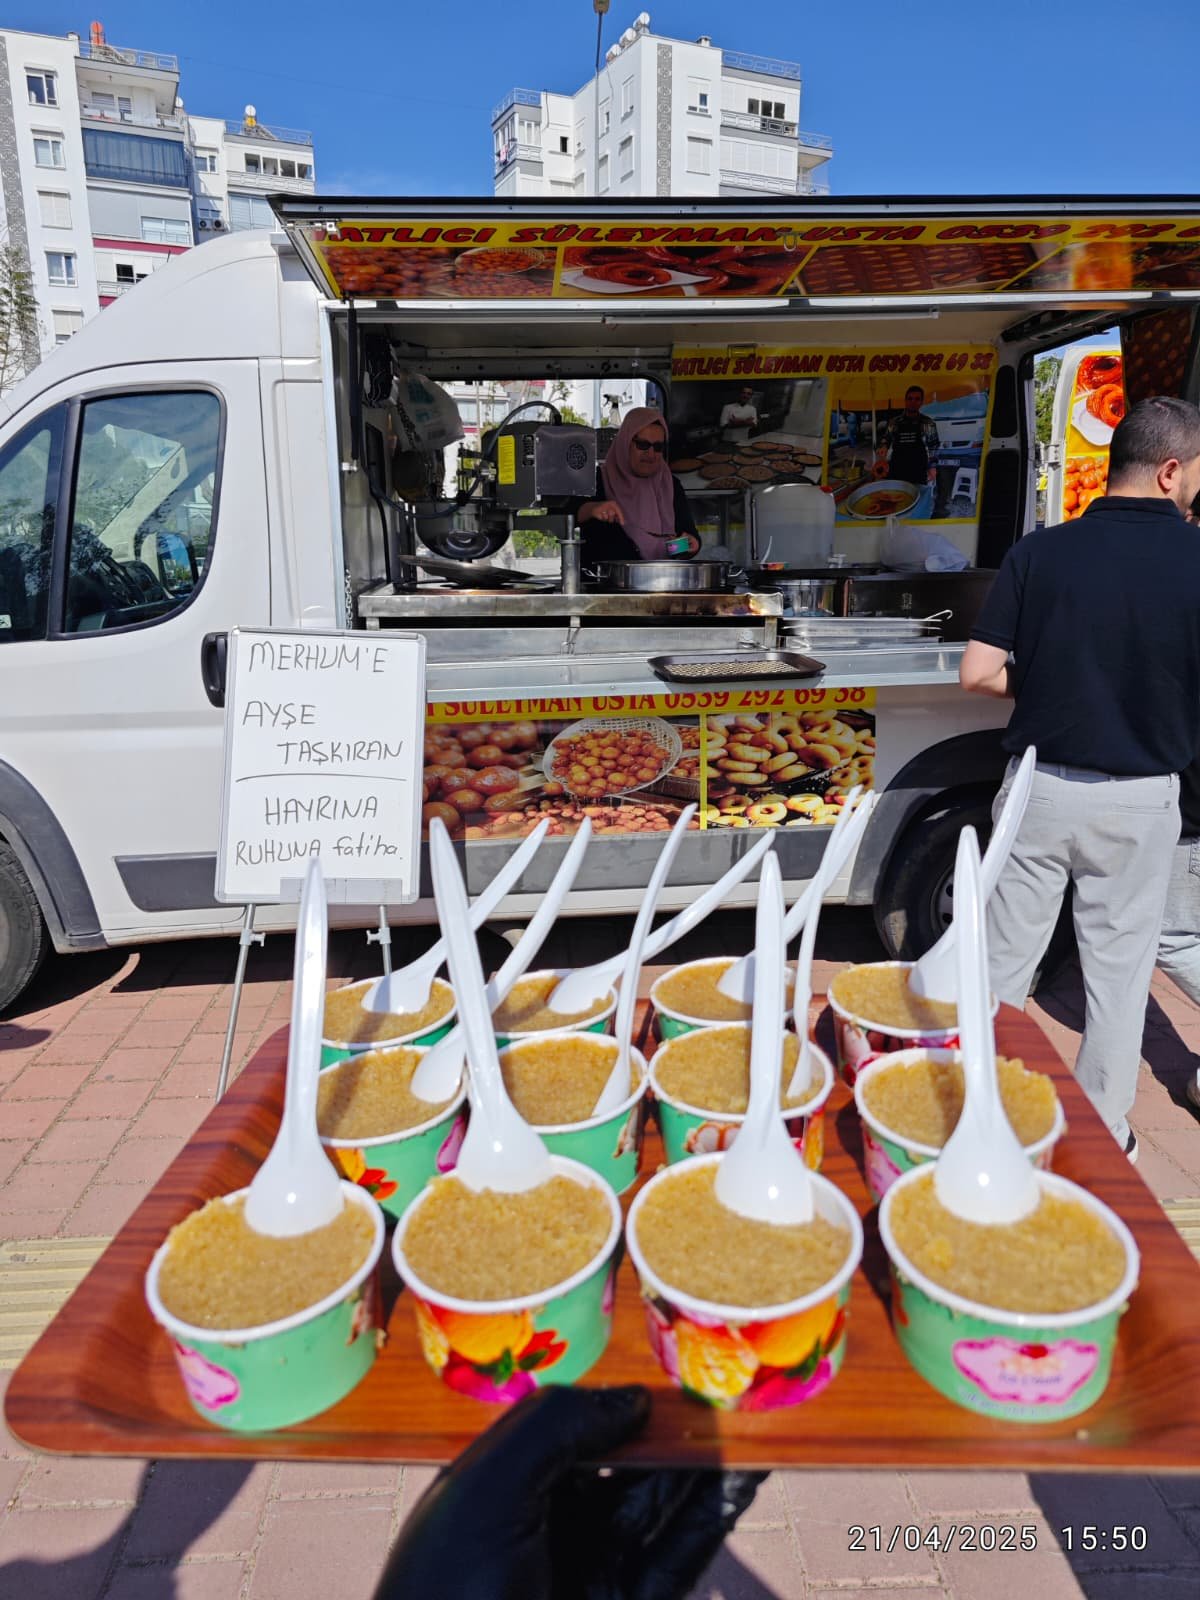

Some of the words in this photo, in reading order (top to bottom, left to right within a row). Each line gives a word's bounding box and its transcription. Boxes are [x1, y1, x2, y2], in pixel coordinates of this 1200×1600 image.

[508, 224, 792, 242] SÜLEYMAN
[800, 225, 927, 241] USTA
[936, 224, 1071, 240] 0539
[825, 354, 865, 373] USTA
[868, 354, 910, 373] 0539
[912, 353, 944, 372] 292
[946, 353, 969, 371] 69
[248, 640, 389, 673] MERHUM'E
[664, 691, 730, 709] 0539
[738, 690, 785, 706] 292
[794, 688, 826, 705] 69
[834, 687, 866, 703] 38
[242, 700, 317, 730] AYŞE
[277, 740, 404, 766] TAŞKIRAN
[265, 795, 378, 826] HAYRINA
[235, 839, 321, 867] RUHUNA
